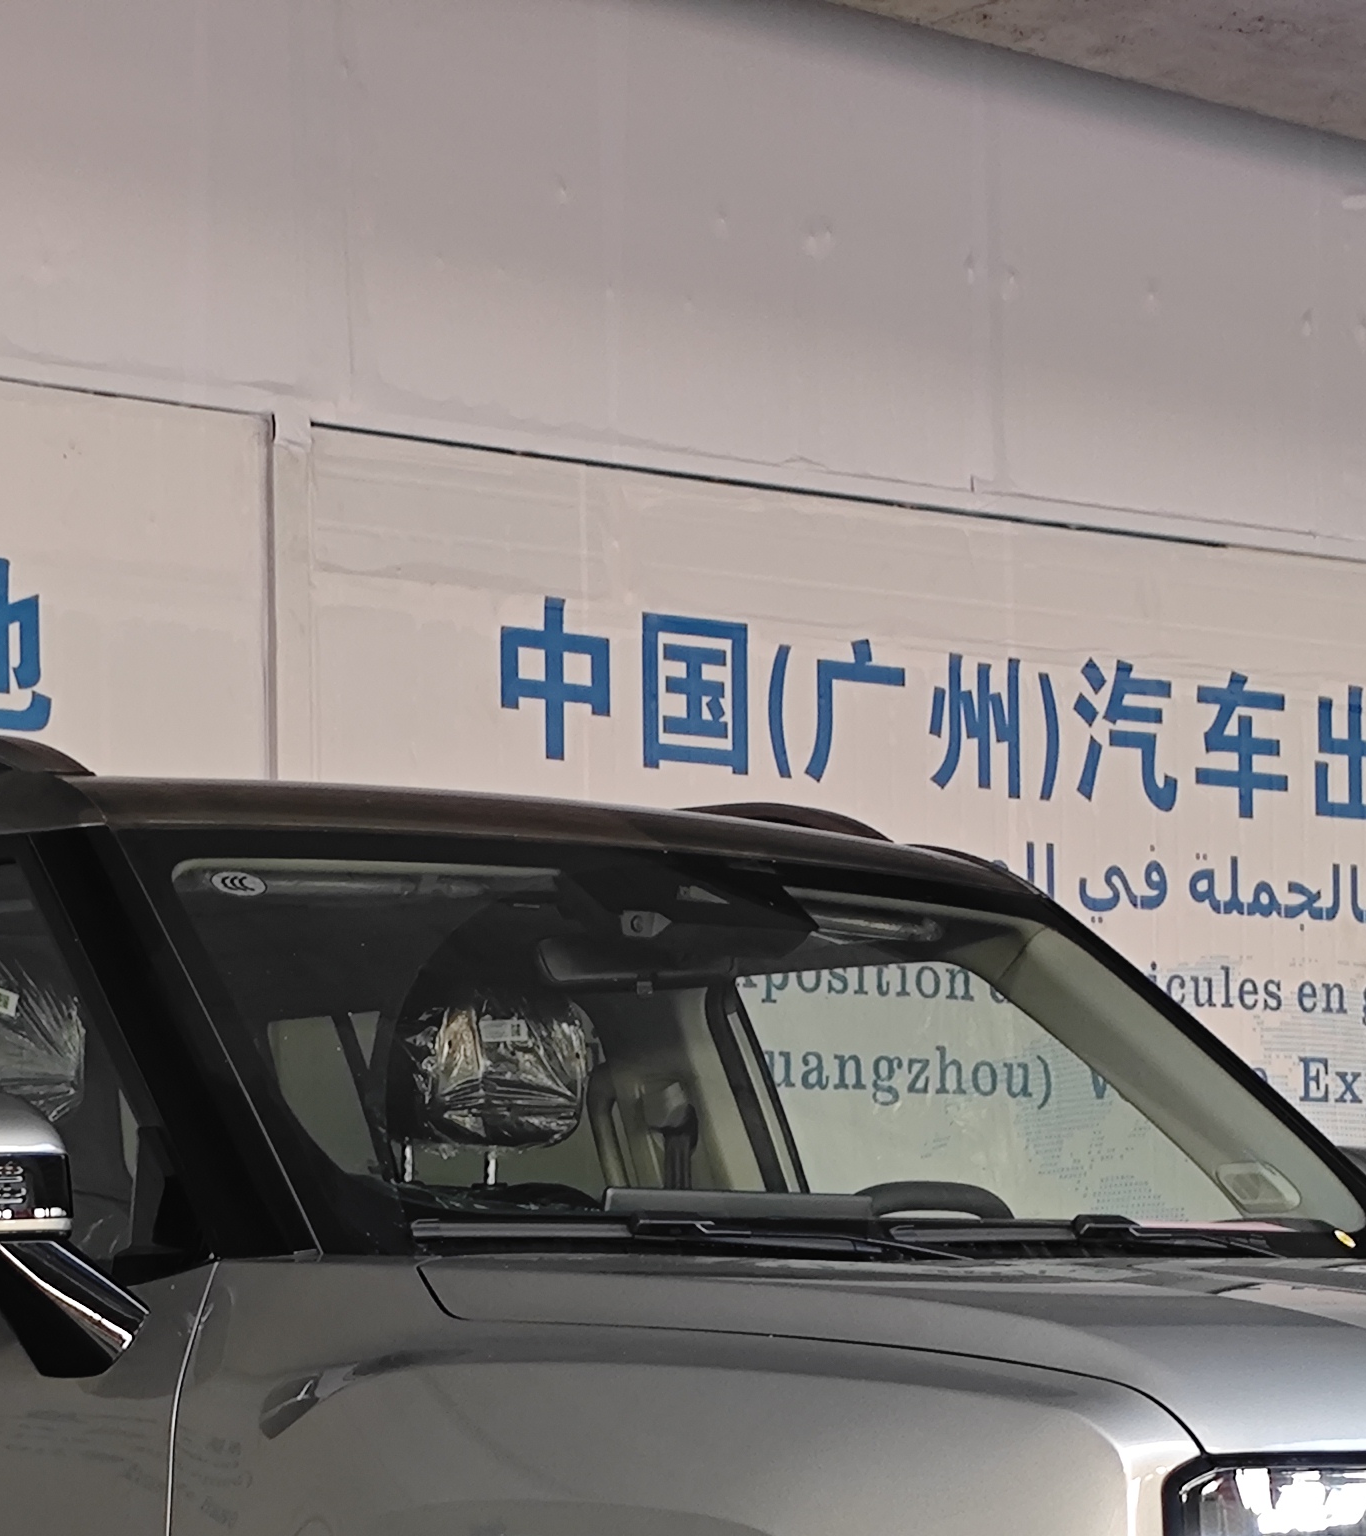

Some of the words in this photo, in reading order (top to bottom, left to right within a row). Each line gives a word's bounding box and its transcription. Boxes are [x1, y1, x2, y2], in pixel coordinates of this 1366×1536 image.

[1078, 844, 1168, 924] في
[735, 961, 975, 1003] position
[1296, 980, 1348, 1015] en
[764, 1044, 1053, 1110] uangzhou)
